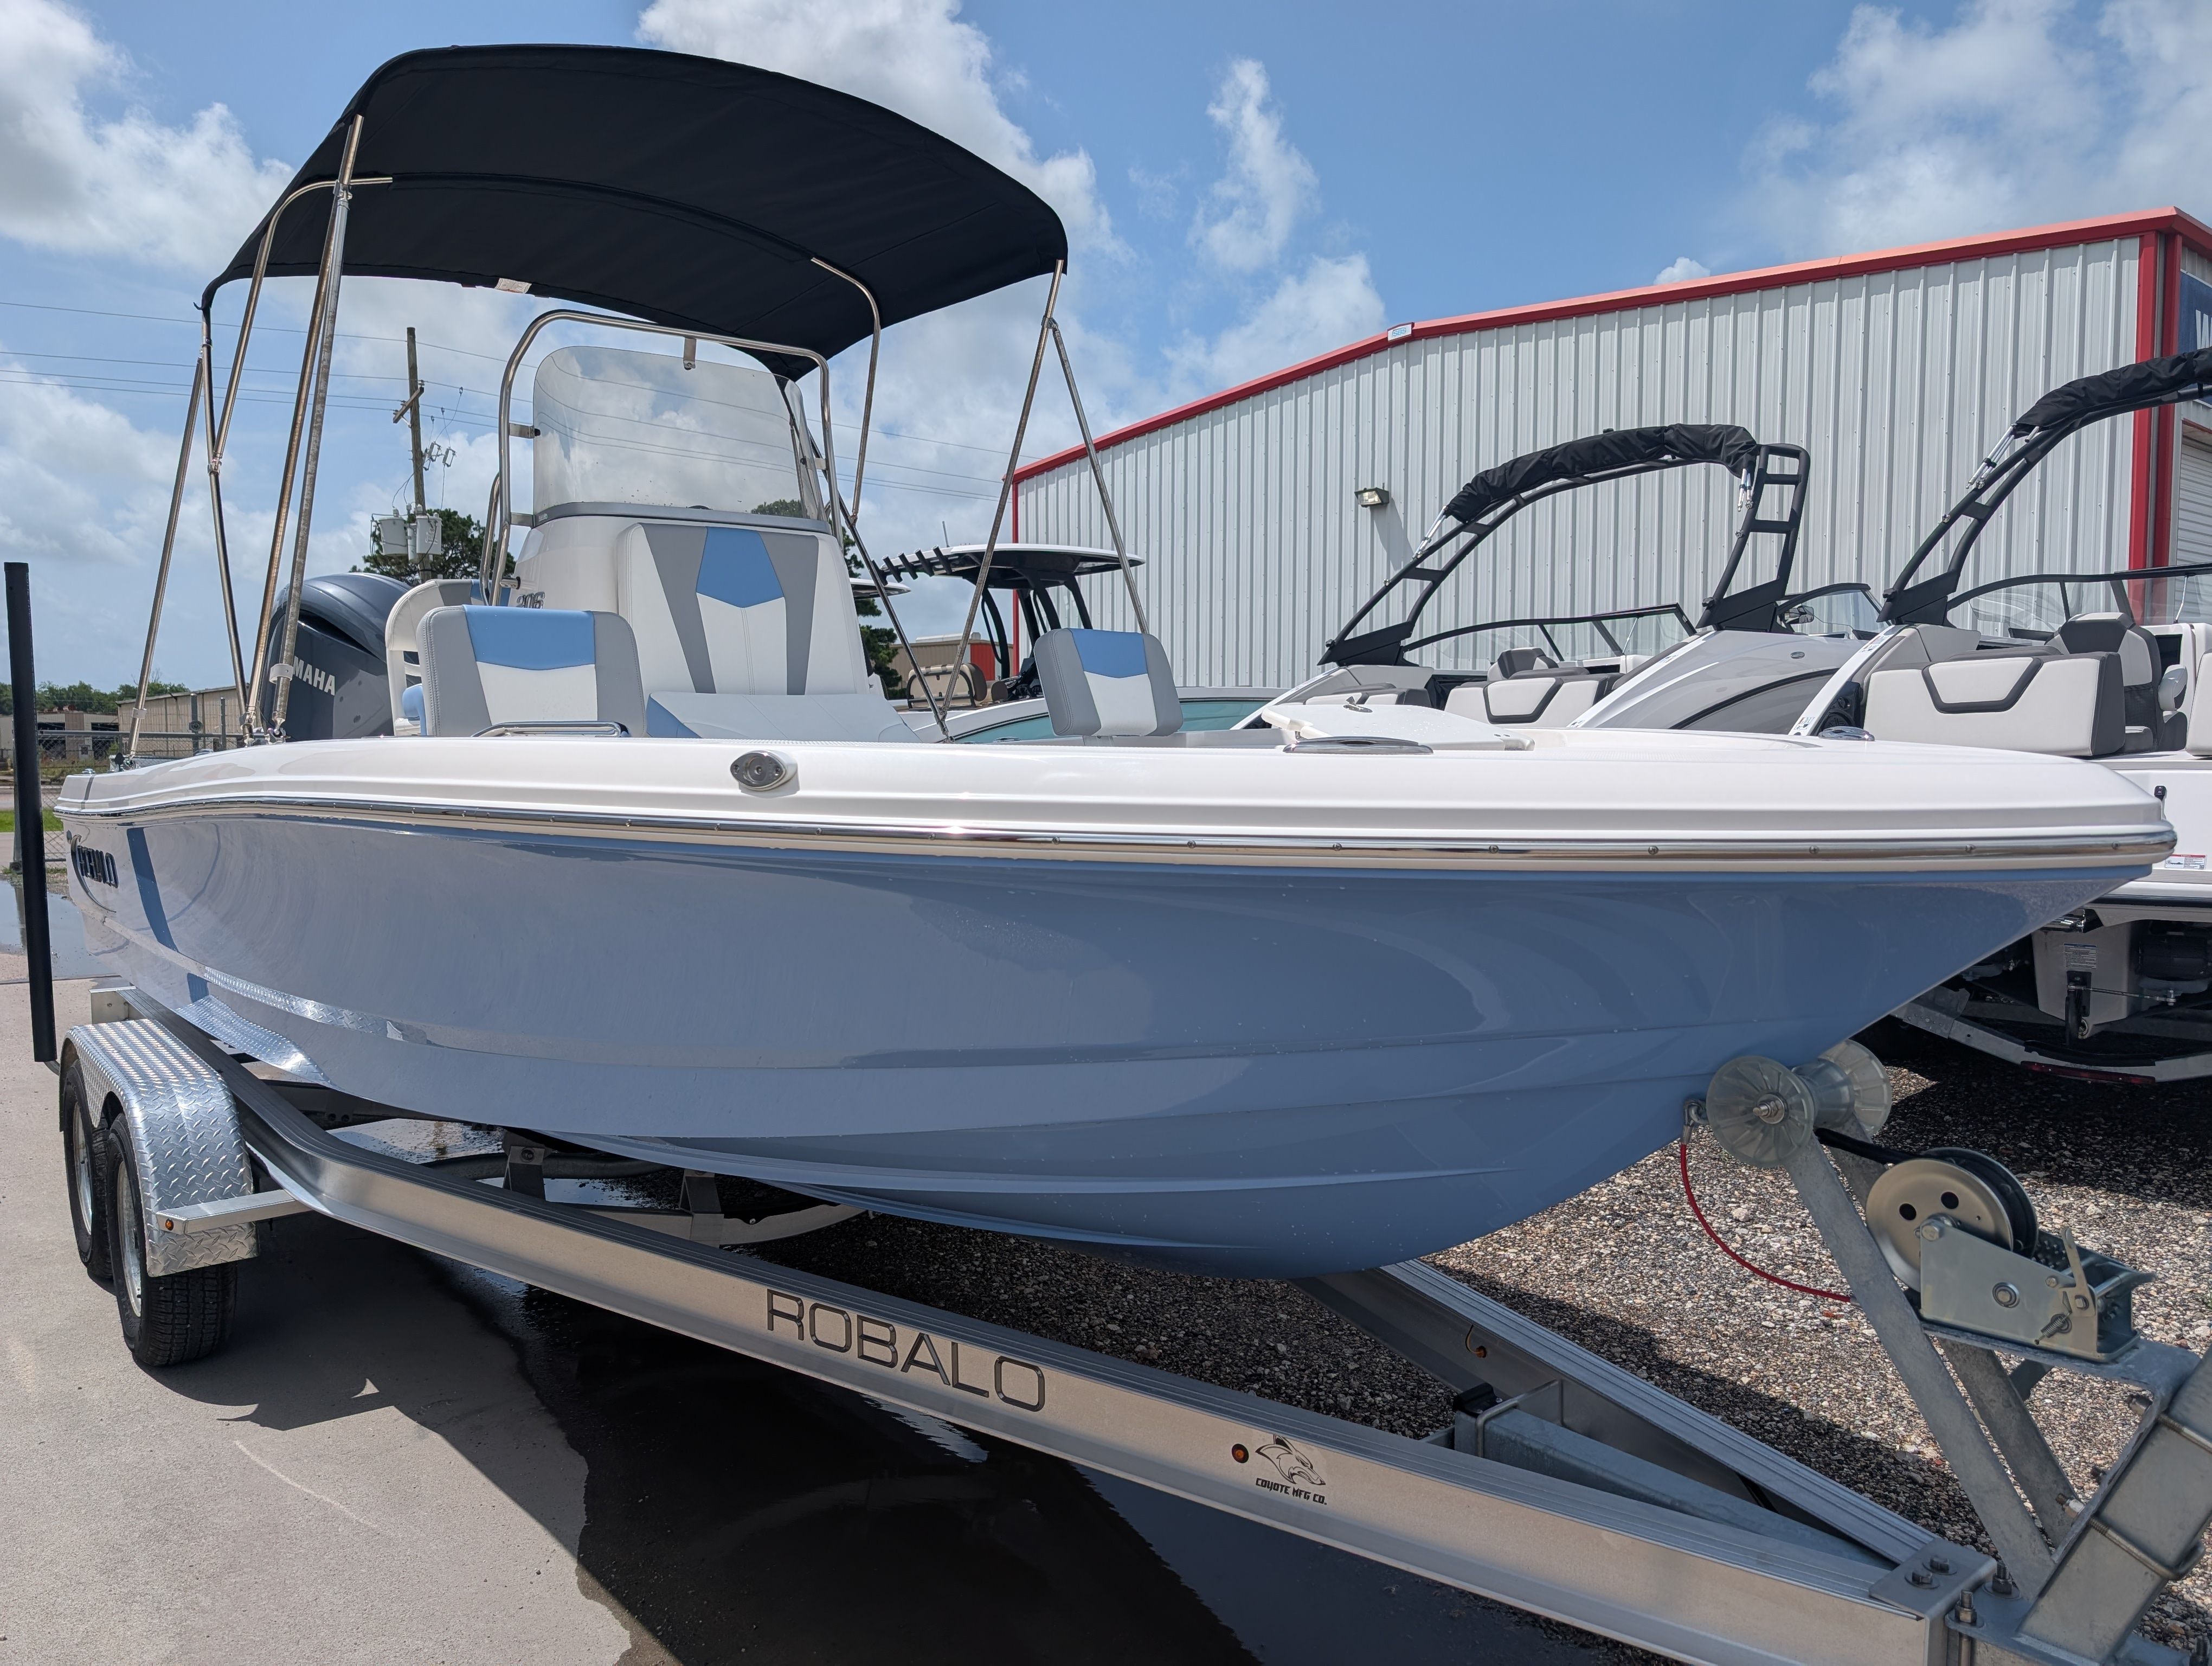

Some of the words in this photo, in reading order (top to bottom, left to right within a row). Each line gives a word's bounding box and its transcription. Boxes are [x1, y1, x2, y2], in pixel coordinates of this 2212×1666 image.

[293, 655, 335, 696] MAHA
[767, 1289, 1045, 1412] ROBALO
[1256, 1477, 1291, 1495] COYOTE
[1292, 1486, 1311, 1501] MFG
[1313, 1494, 1327, 1505] CO.
